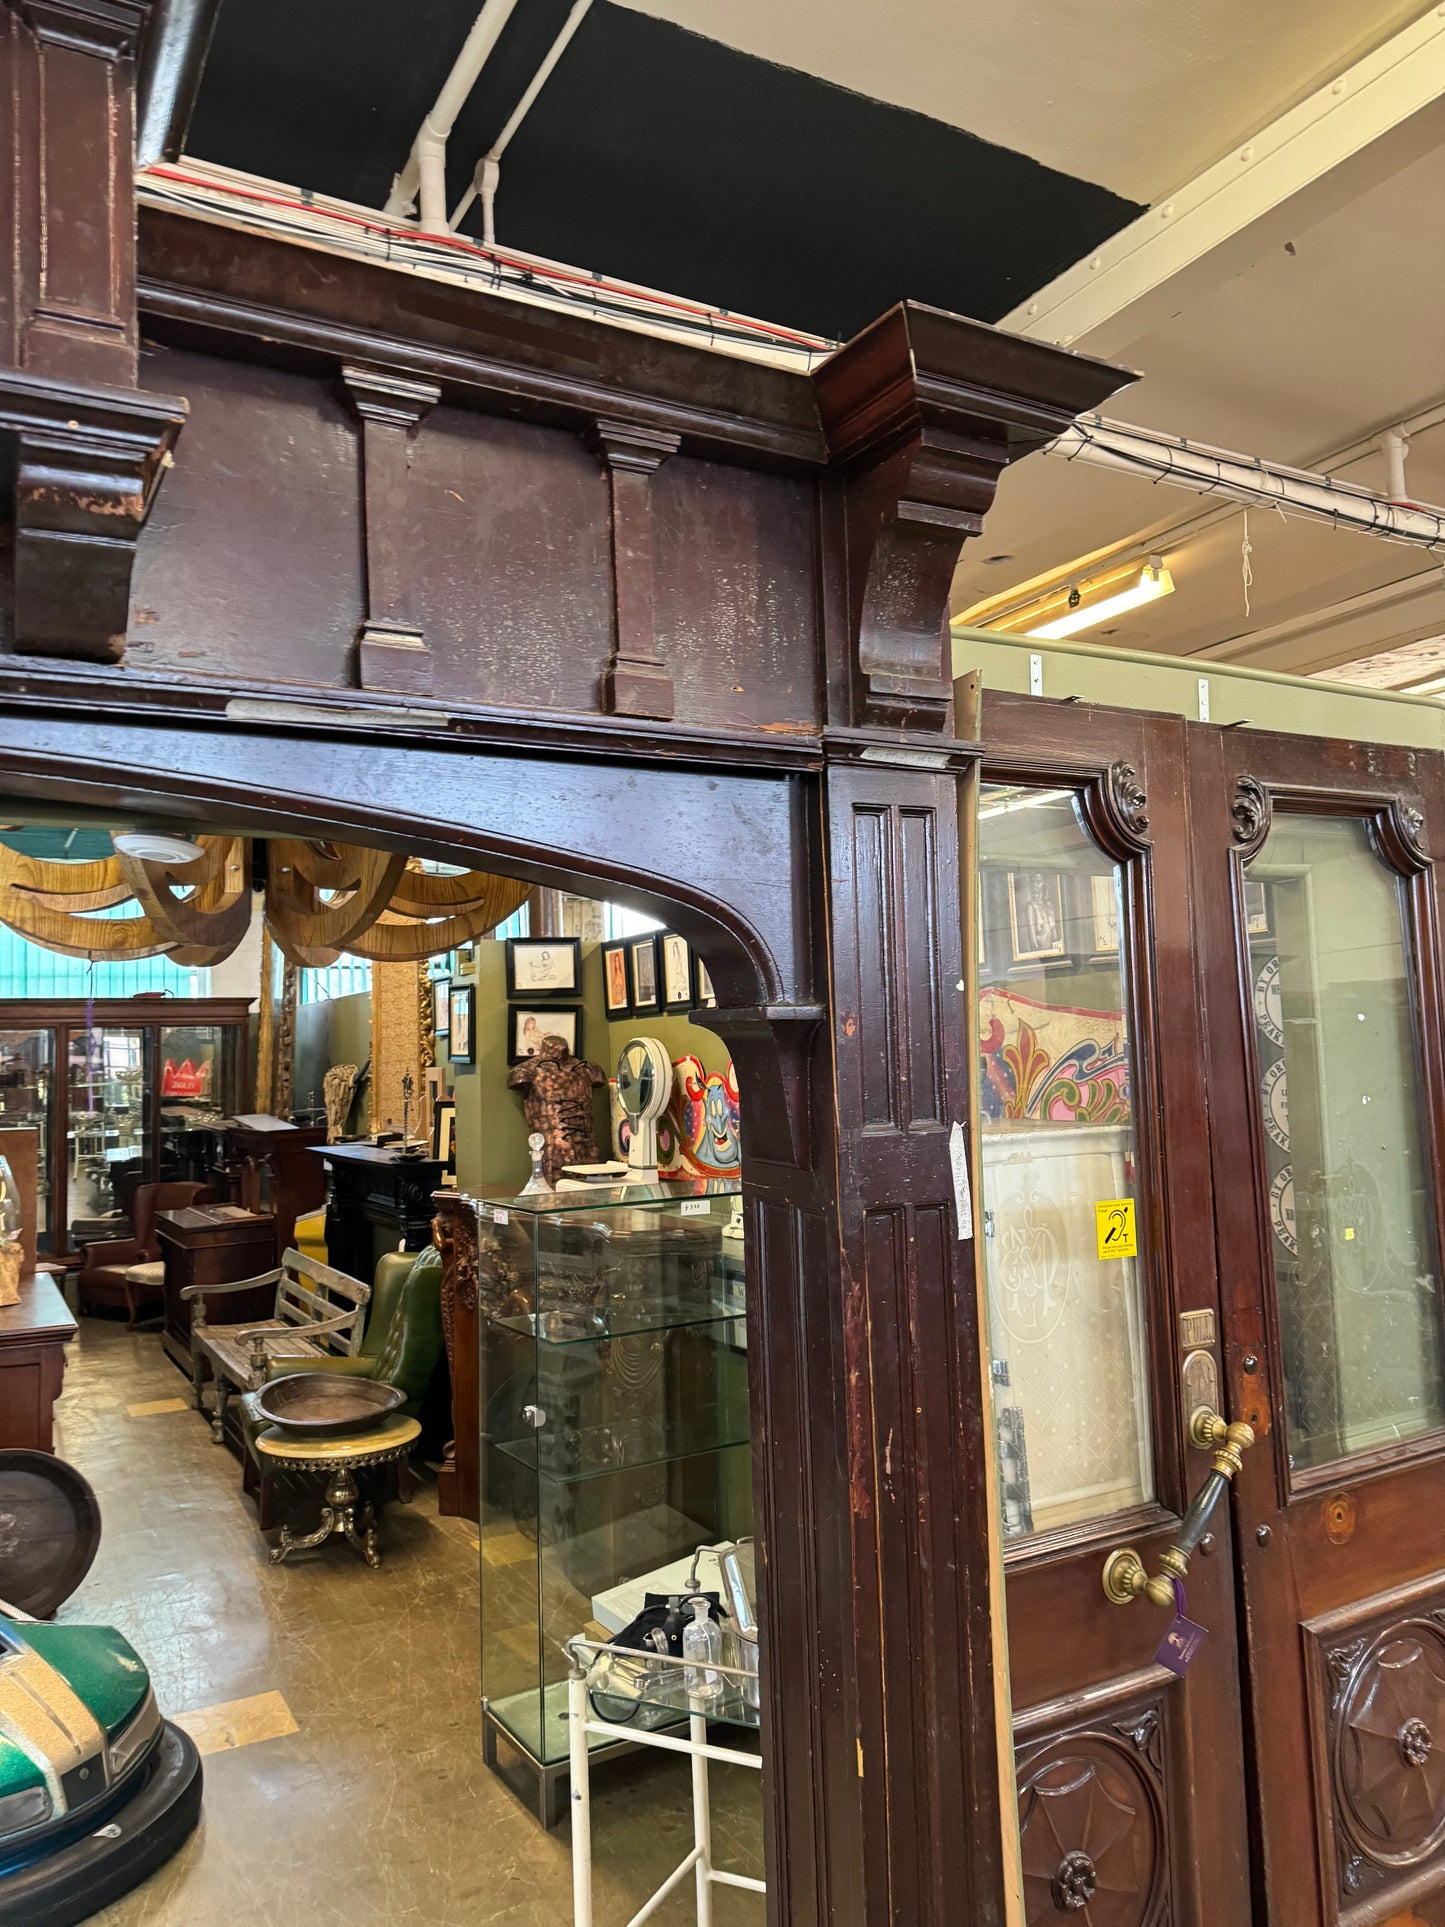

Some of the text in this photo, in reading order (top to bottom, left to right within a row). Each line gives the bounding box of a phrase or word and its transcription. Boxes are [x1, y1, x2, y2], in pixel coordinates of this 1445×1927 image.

[1259, 1013, 1284, 1045] PEAK
[1264, 1117, 1289, 1150] PEAK
[1122, 1233, 1129, 1243] T
[1274, 1221, 1297, 1250] PEAK
[1183, 1317, 1213, 1344] PULL
